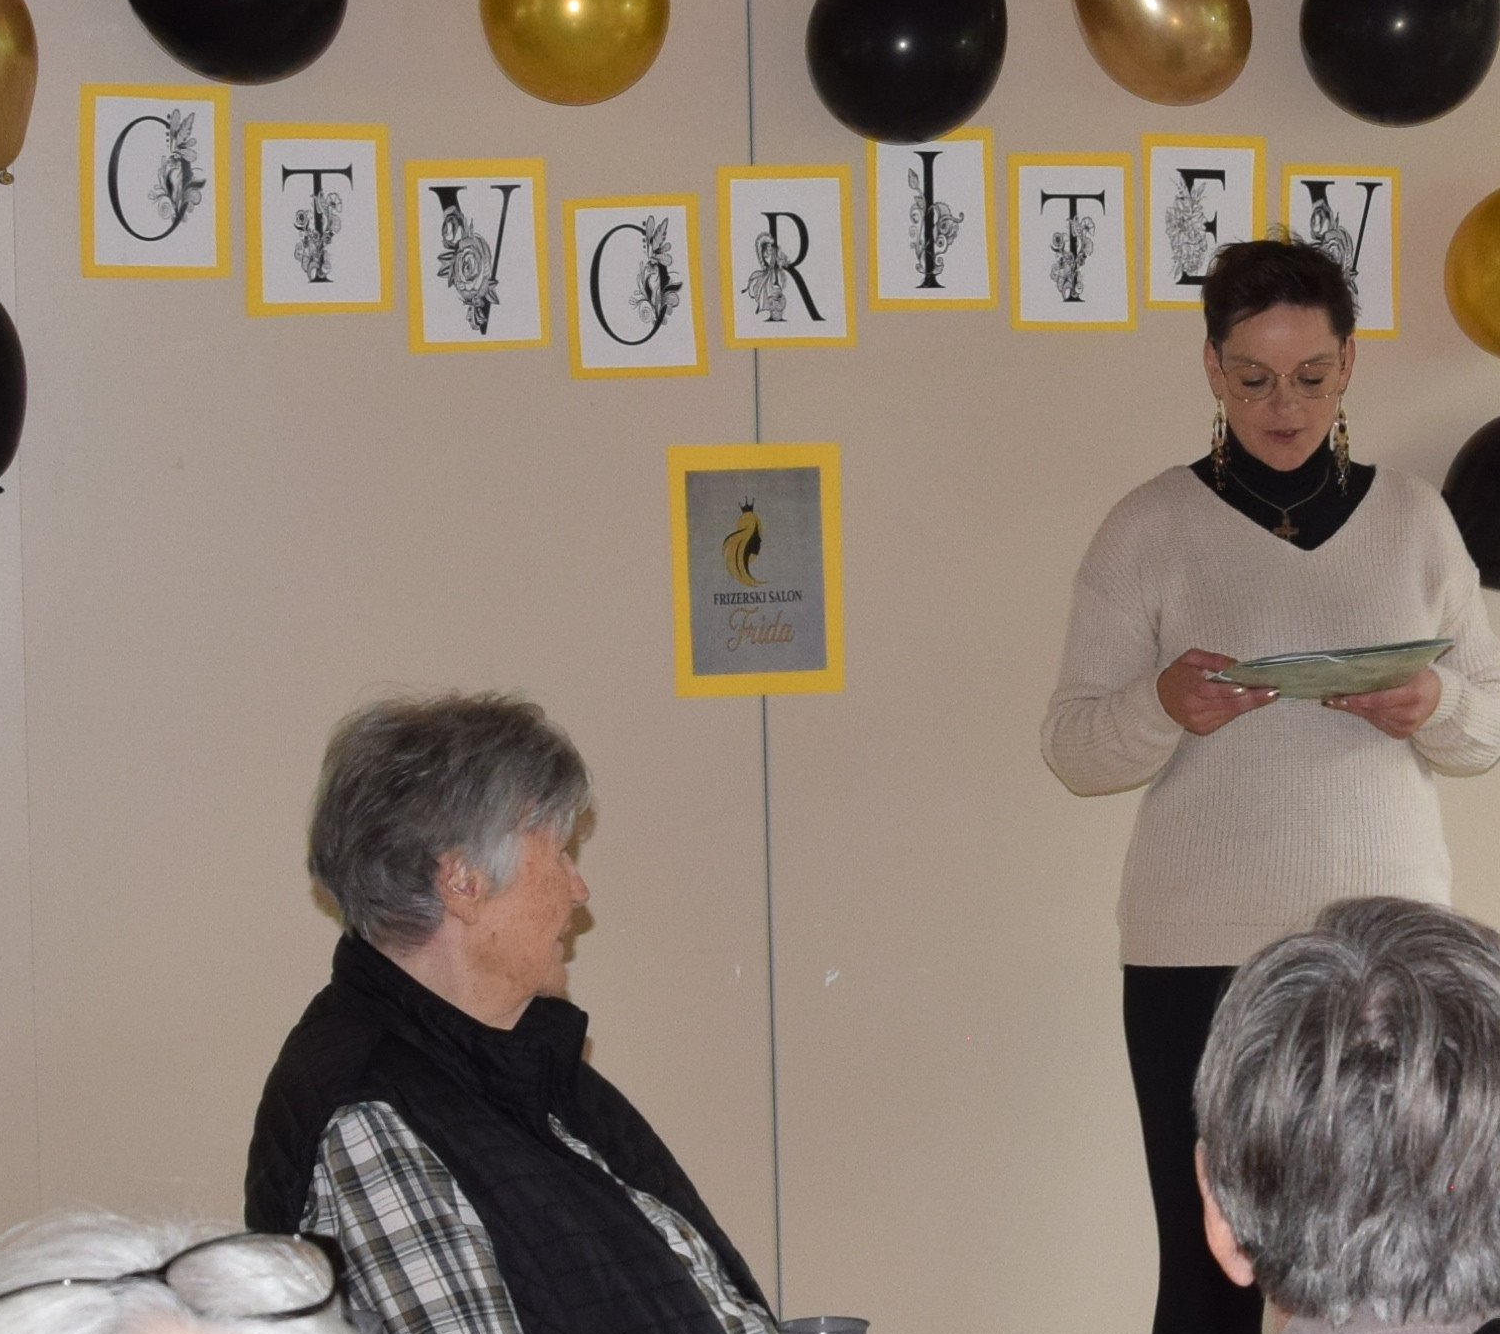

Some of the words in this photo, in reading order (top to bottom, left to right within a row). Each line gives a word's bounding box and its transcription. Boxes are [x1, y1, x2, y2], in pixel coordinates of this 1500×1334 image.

[713, 592, 767, 605] FRIZERSKI
[769, 591, 802, 603] SALON
[728, 607, 794, 650] Frida
